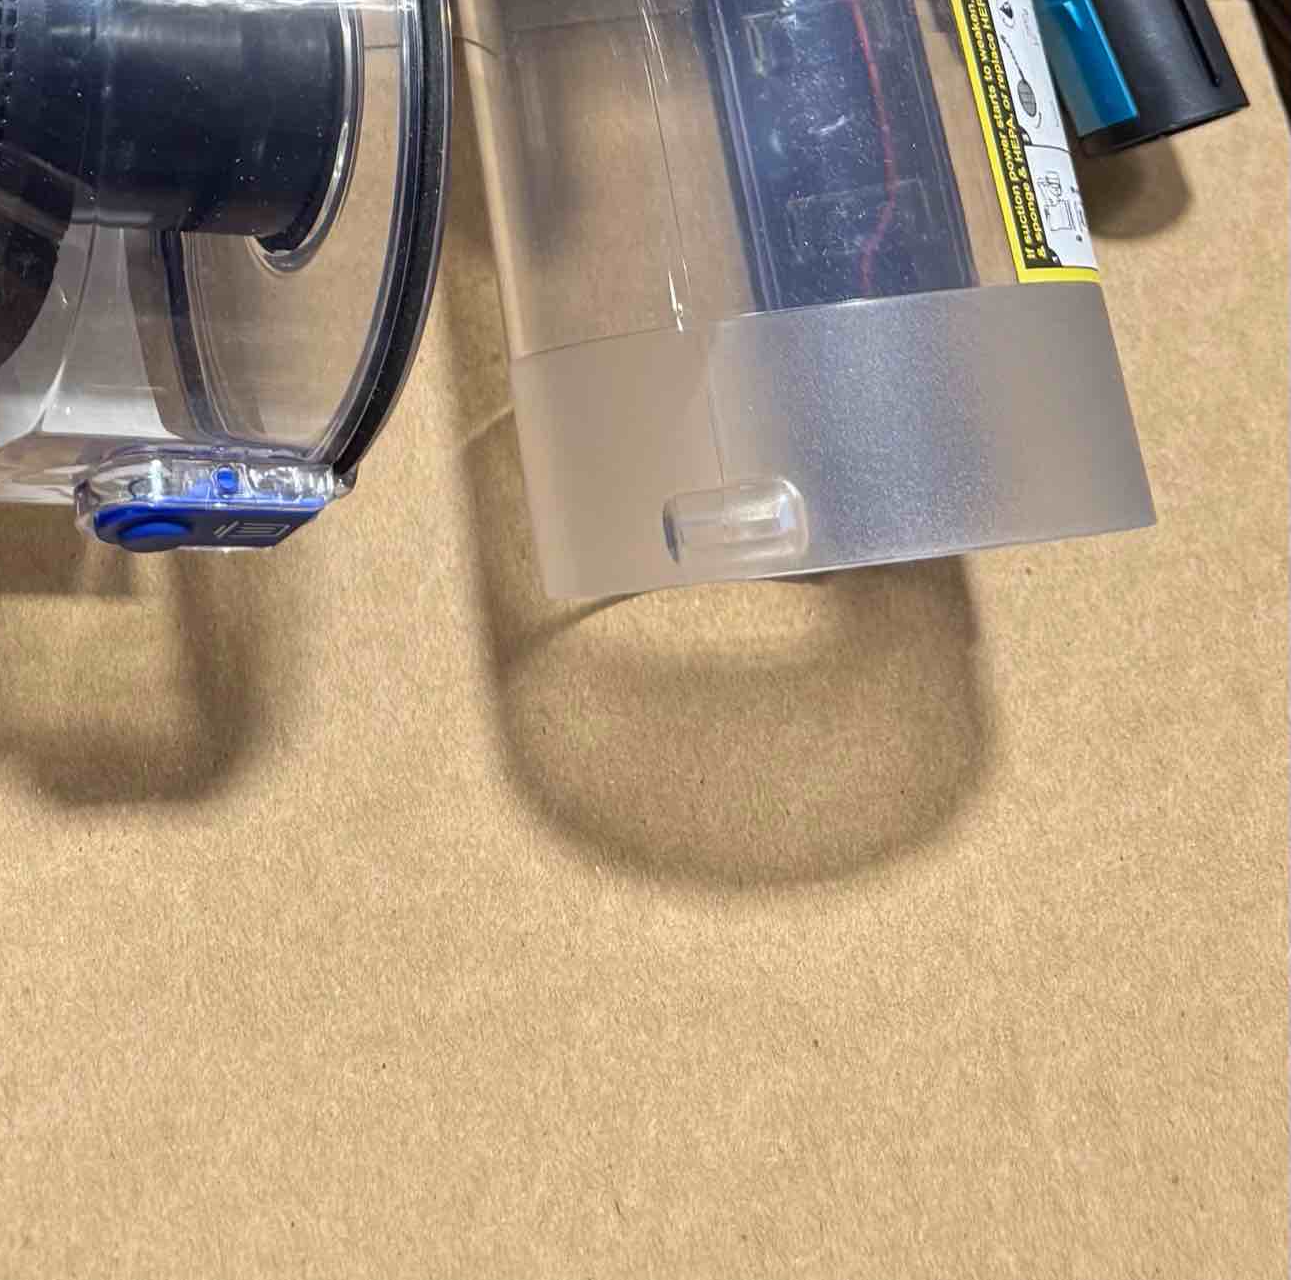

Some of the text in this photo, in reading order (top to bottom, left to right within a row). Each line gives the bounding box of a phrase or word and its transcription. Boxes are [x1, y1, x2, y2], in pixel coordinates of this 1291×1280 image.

[967, 0, 989, 62] weaken,
[982, 65, 993, 81] to
[987, 32, 1007, 89] replace
[988, 85, 1005, 128] starts
[1000, 93, 1011, 111] or
[998, 132, 1019, 181] power
[1012, 185, 1033, 245] suction
[1022, 182, 1043, 242] sponge
[1025, 247, 1037, 259] If
